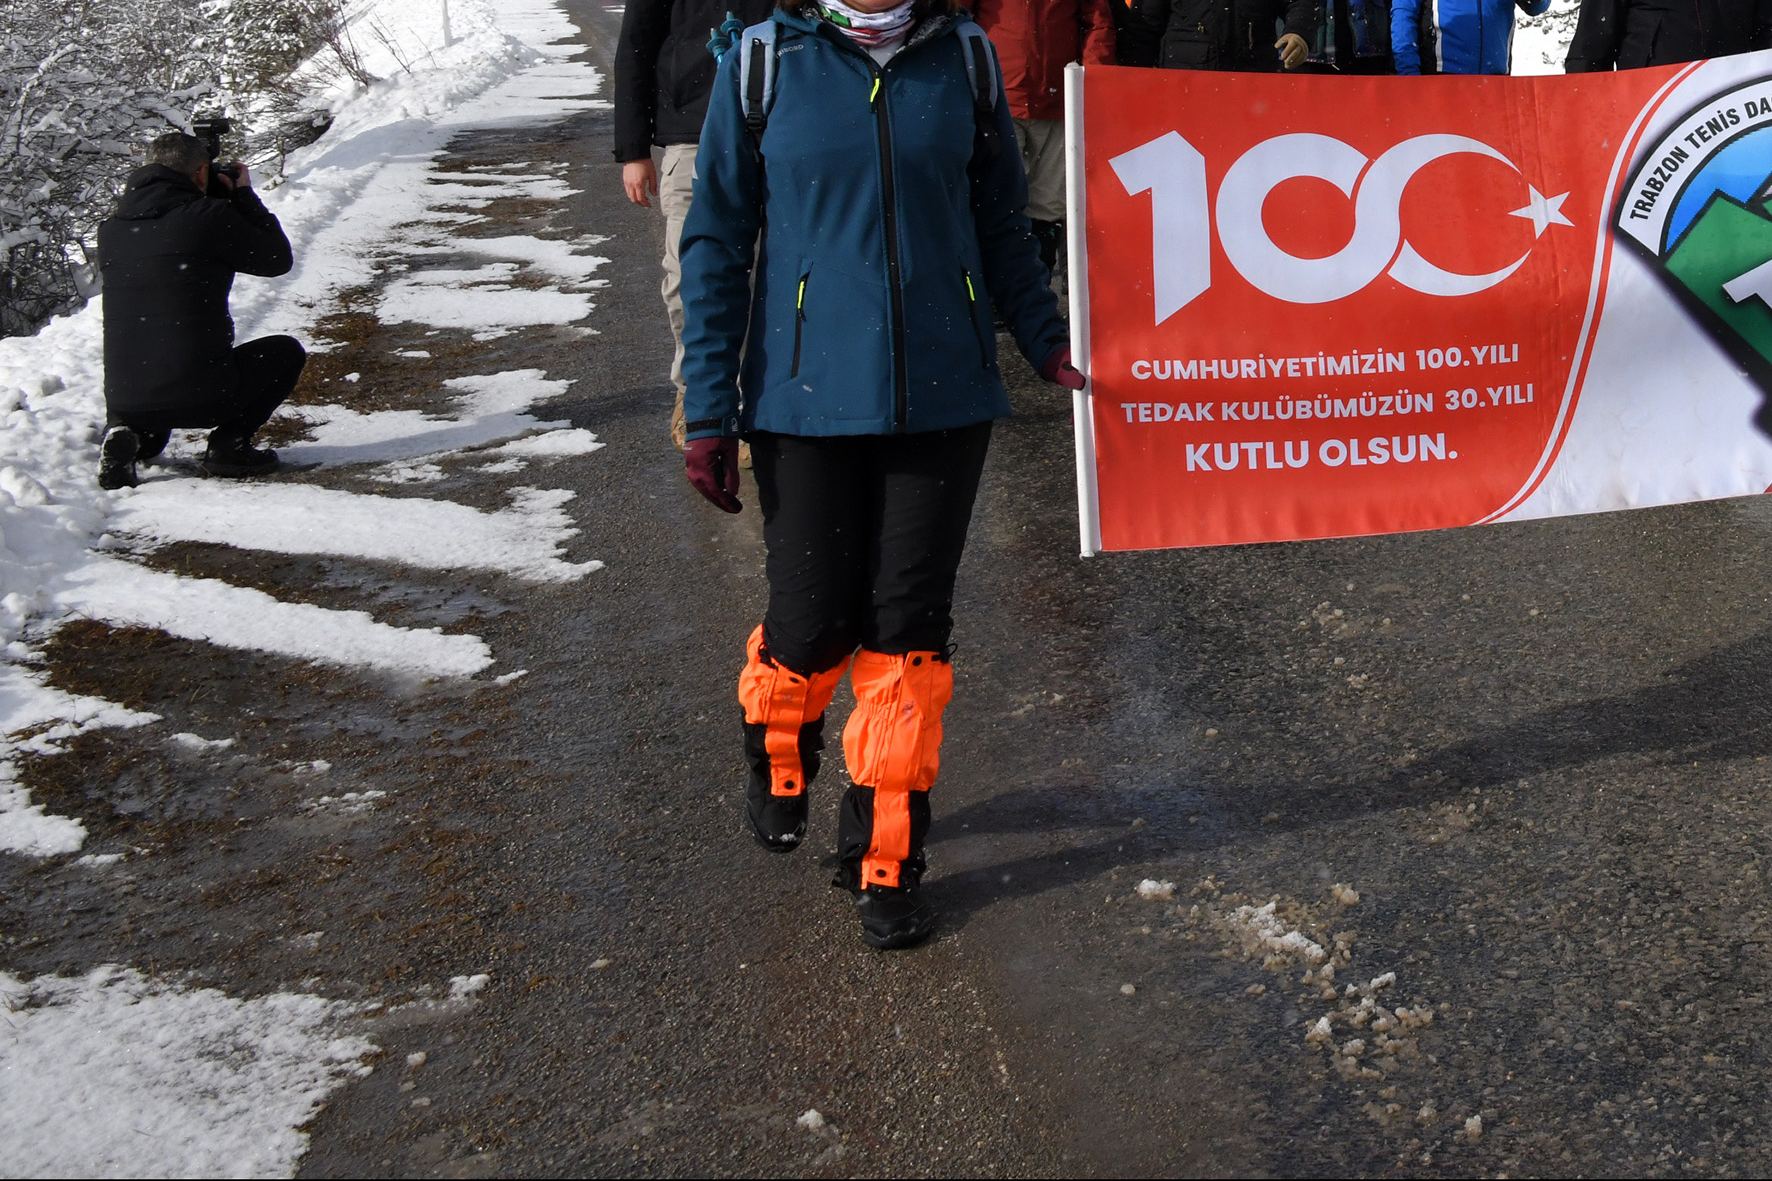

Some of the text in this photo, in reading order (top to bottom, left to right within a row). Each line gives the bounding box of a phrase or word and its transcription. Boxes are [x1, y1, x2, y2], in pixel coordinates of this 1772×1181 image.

[776, 44, 804, 59] RIBORD
[1629, 145, 1690, 221] TRABZON
[1684, 109, 1741, 150] TENİS
[1108, 130, 1534, 327] 100
[1131, 343, 1519, 380] CUMHURİYETİMİZİN 100.YILI
[1120, 383, 1534, 423] TEDAK KULÜBÜMÜZÜN 30.YILI
[1185, 432, 1458, 472] KUTLU OLSUN.
